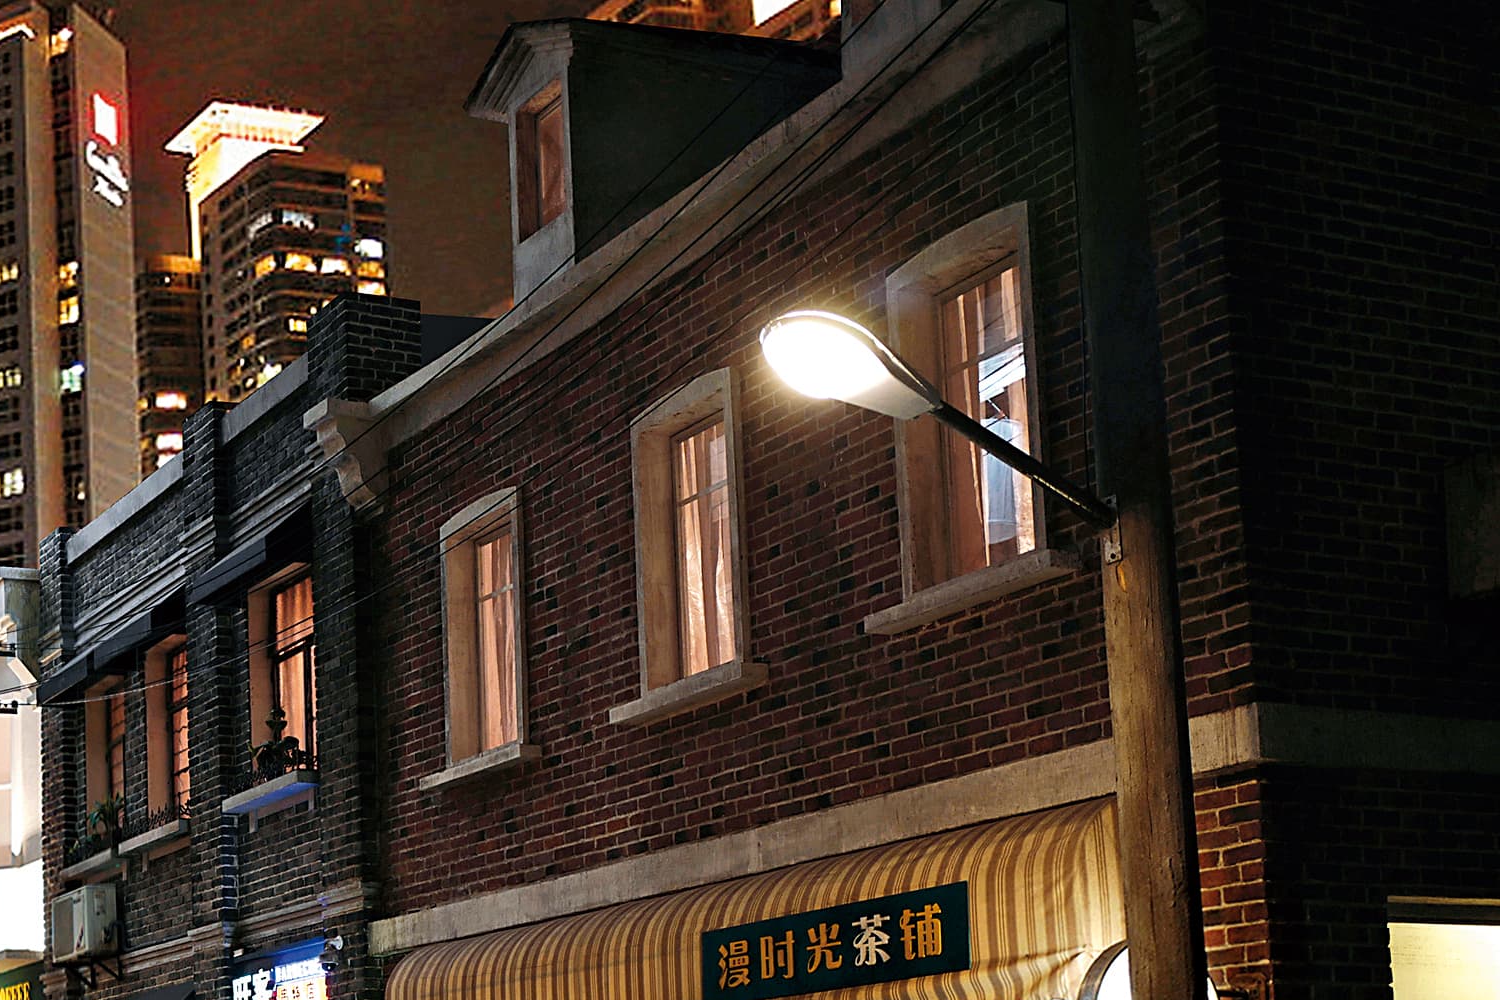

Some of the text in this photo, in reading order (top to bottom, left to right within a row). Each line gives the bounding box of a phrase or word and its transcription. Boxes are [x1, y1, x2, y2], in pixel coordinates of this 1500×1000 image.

[717, 903, 943, 989] 漫时光茶铺
